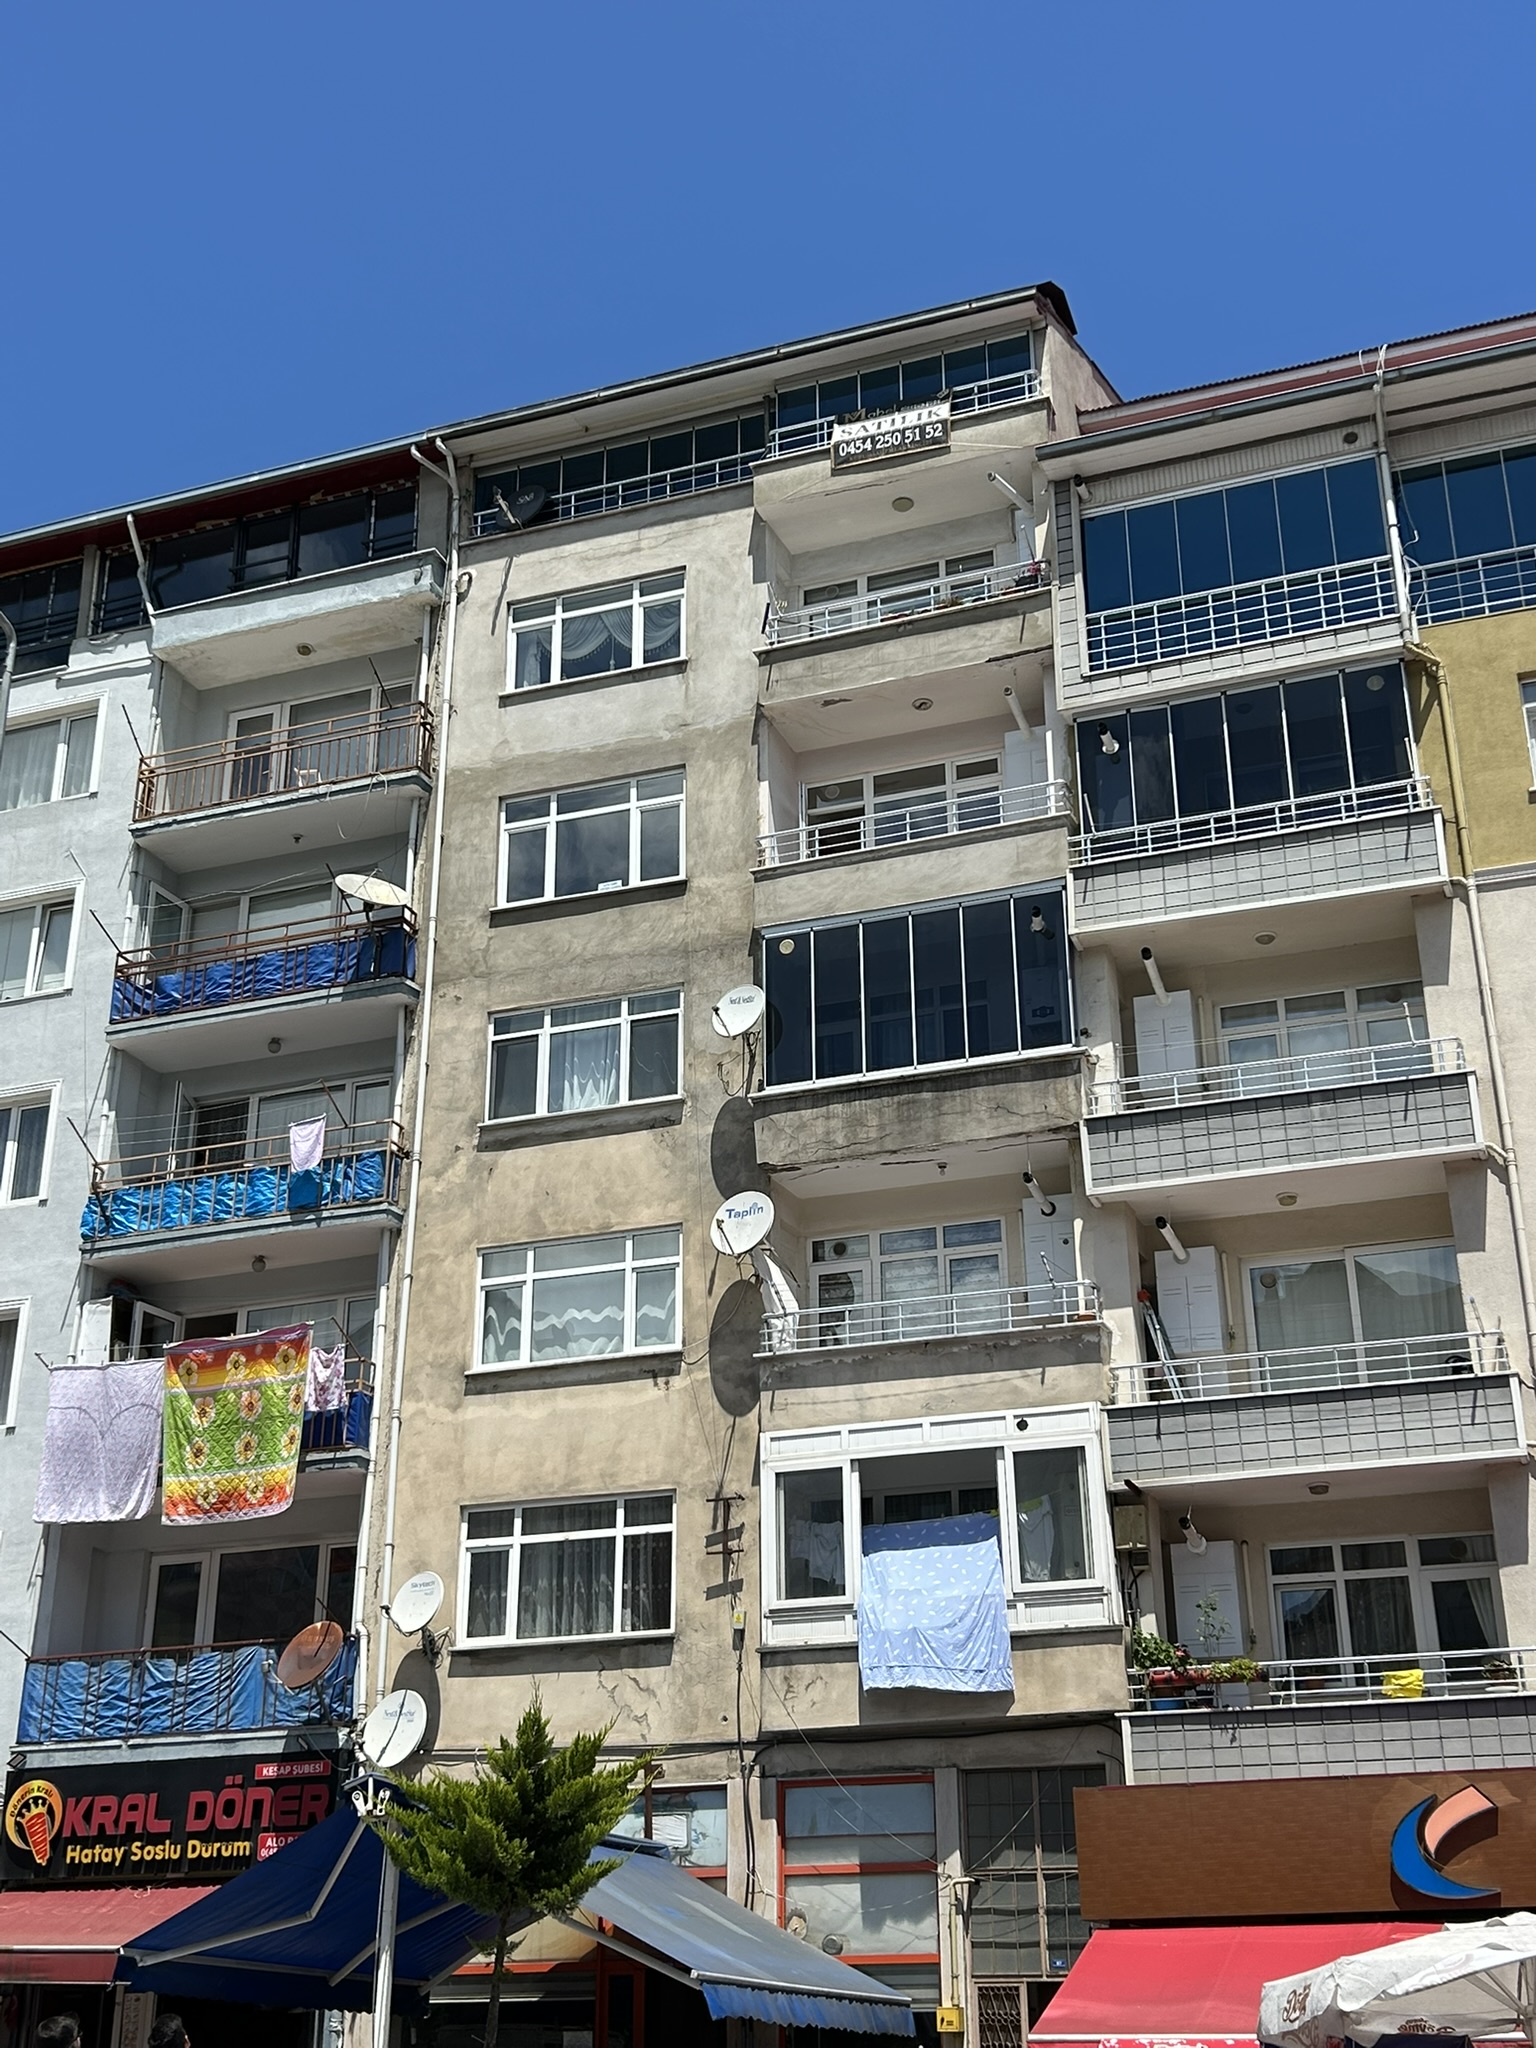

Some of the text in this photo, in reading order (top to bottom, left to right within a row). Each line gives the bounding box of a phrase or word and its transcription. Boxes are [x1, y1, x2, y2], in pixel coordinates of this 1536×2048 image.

[840, 406, 944, 438] SATILIK
[839, 438, 872, 457] 0454
[875, 432, 901, 449] 250
[904, 428, 921, 444] 51
[925, 423, 943, 439] 52
[725, 1202, 764, 1219] Taplin
[292, 1761, 323, 1775] ŞUBESİ
[10, 1787, 35, 1818] Dönerin
[62, 1774, 329, 1837] KRAL DÖNER
[66, 1844, 124, 1867] Hatay
[130, 1839, 181, 1861] Soslu
[265, 1836, 285, 1847] ALO
